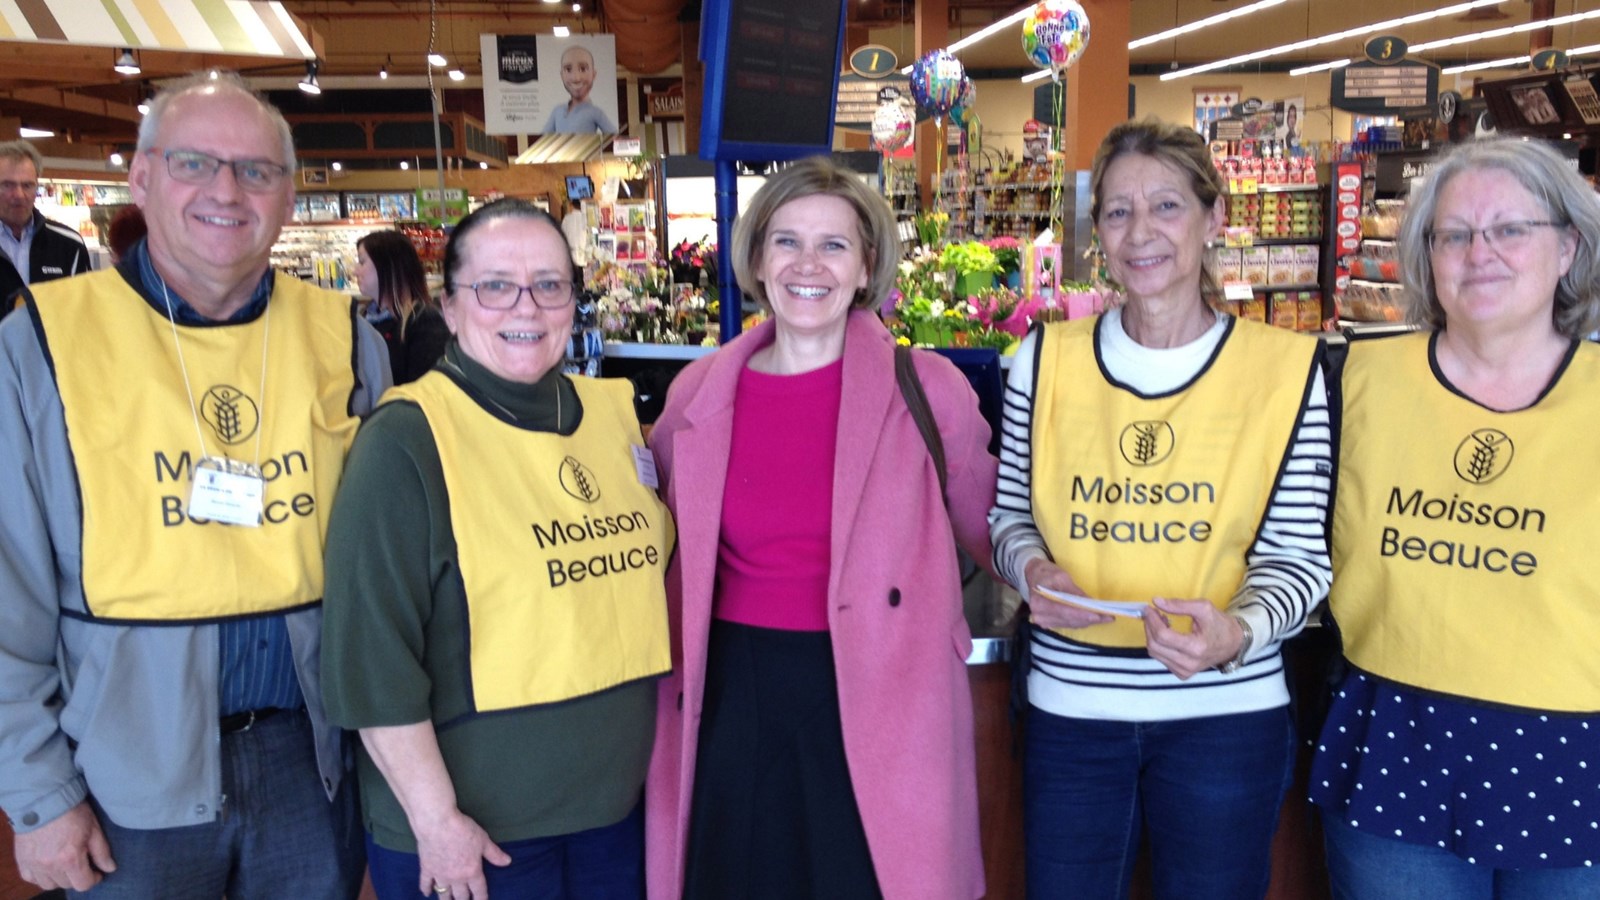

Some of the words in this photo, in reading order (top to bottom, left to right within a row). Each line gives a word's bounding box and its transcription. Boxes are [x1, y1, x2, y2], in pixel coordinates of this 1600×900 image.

[869, 52, 879, 71] 1
[1382, 40, 1392, 58] 3
[1071, 475, 1215, 504] Moisson
[161, 493, 315, 527] Bce
[1386, 486, 1546, 533] Moisson
[532, 511, 650, 549] Moisson
[1069, 512, 1212, 543] Beauce
[547, 545, 658, 588] Beauce
[1380, 526, 1538, 577] Beauce
